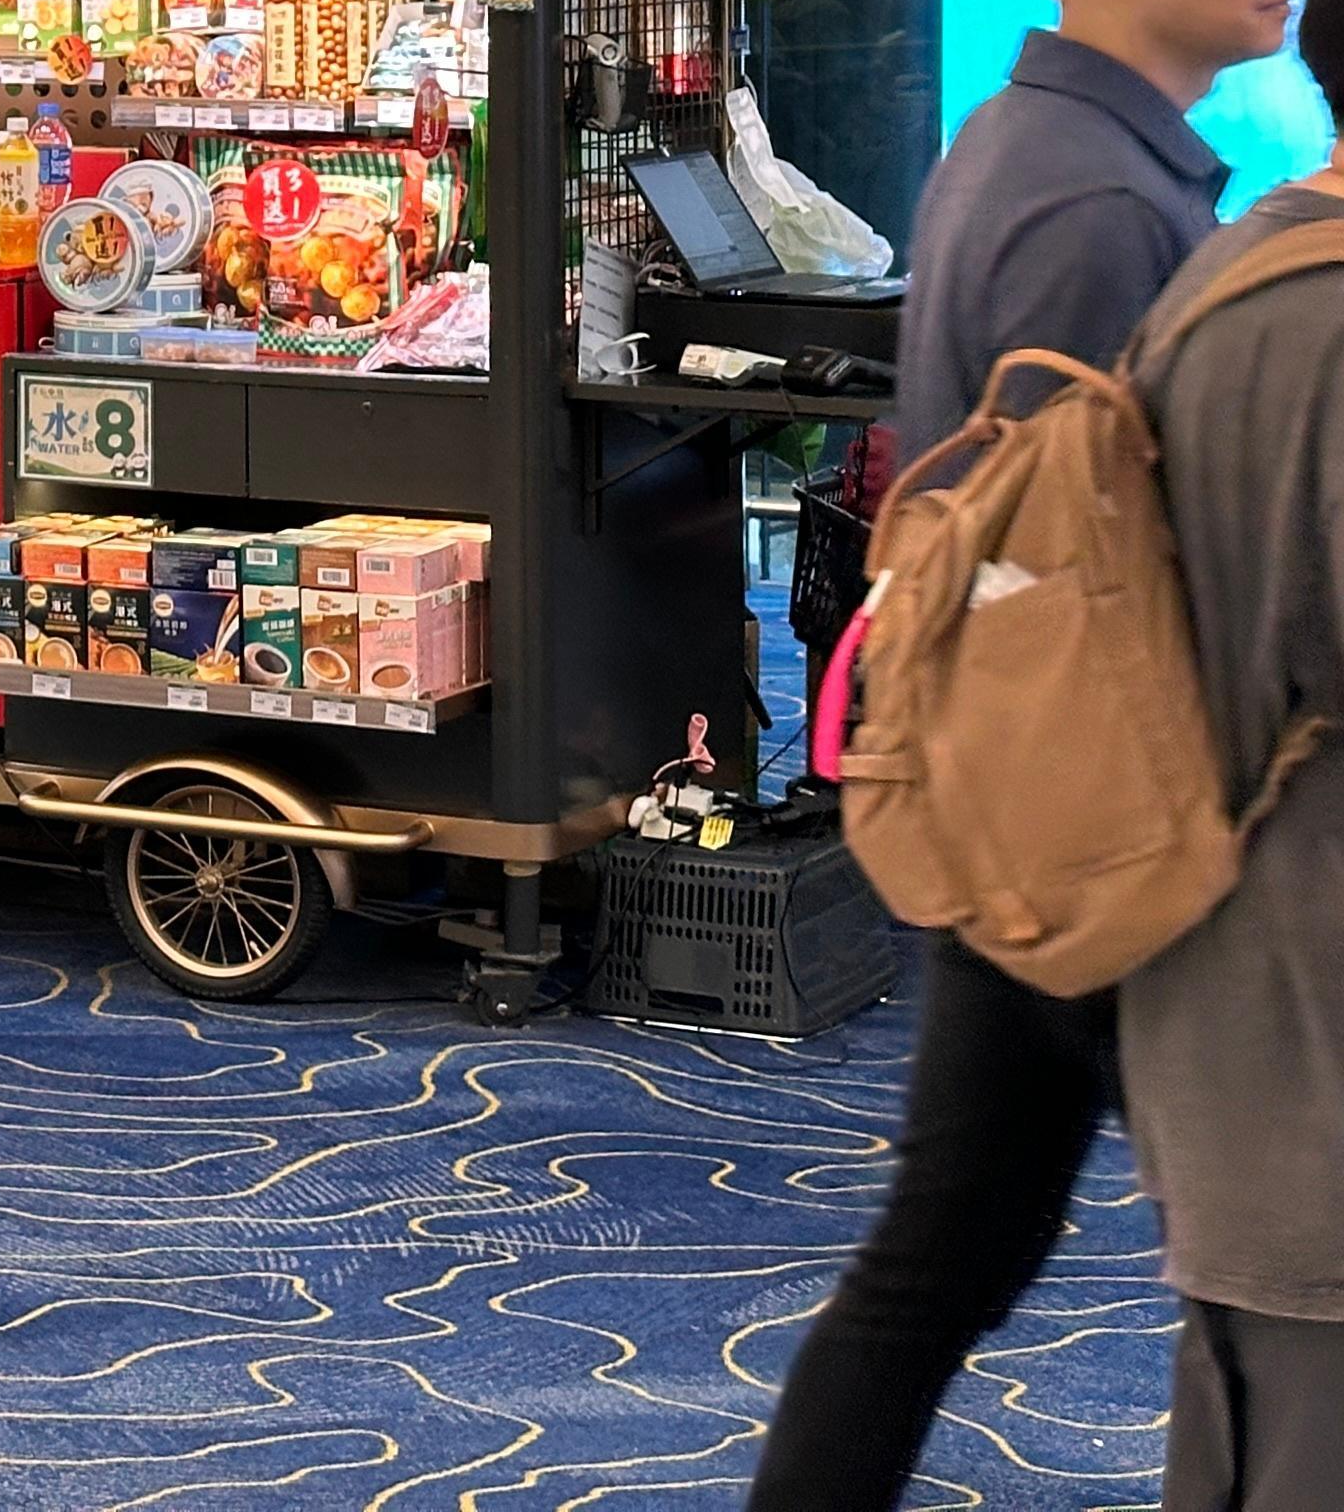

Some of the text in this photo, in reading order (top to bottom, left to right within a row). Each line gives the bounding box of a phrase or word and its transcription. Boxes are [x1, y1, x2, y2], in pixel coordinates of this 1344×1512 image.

[41, 398, 136, 460] 水 8
[38, 441, 81, 456] WATER
